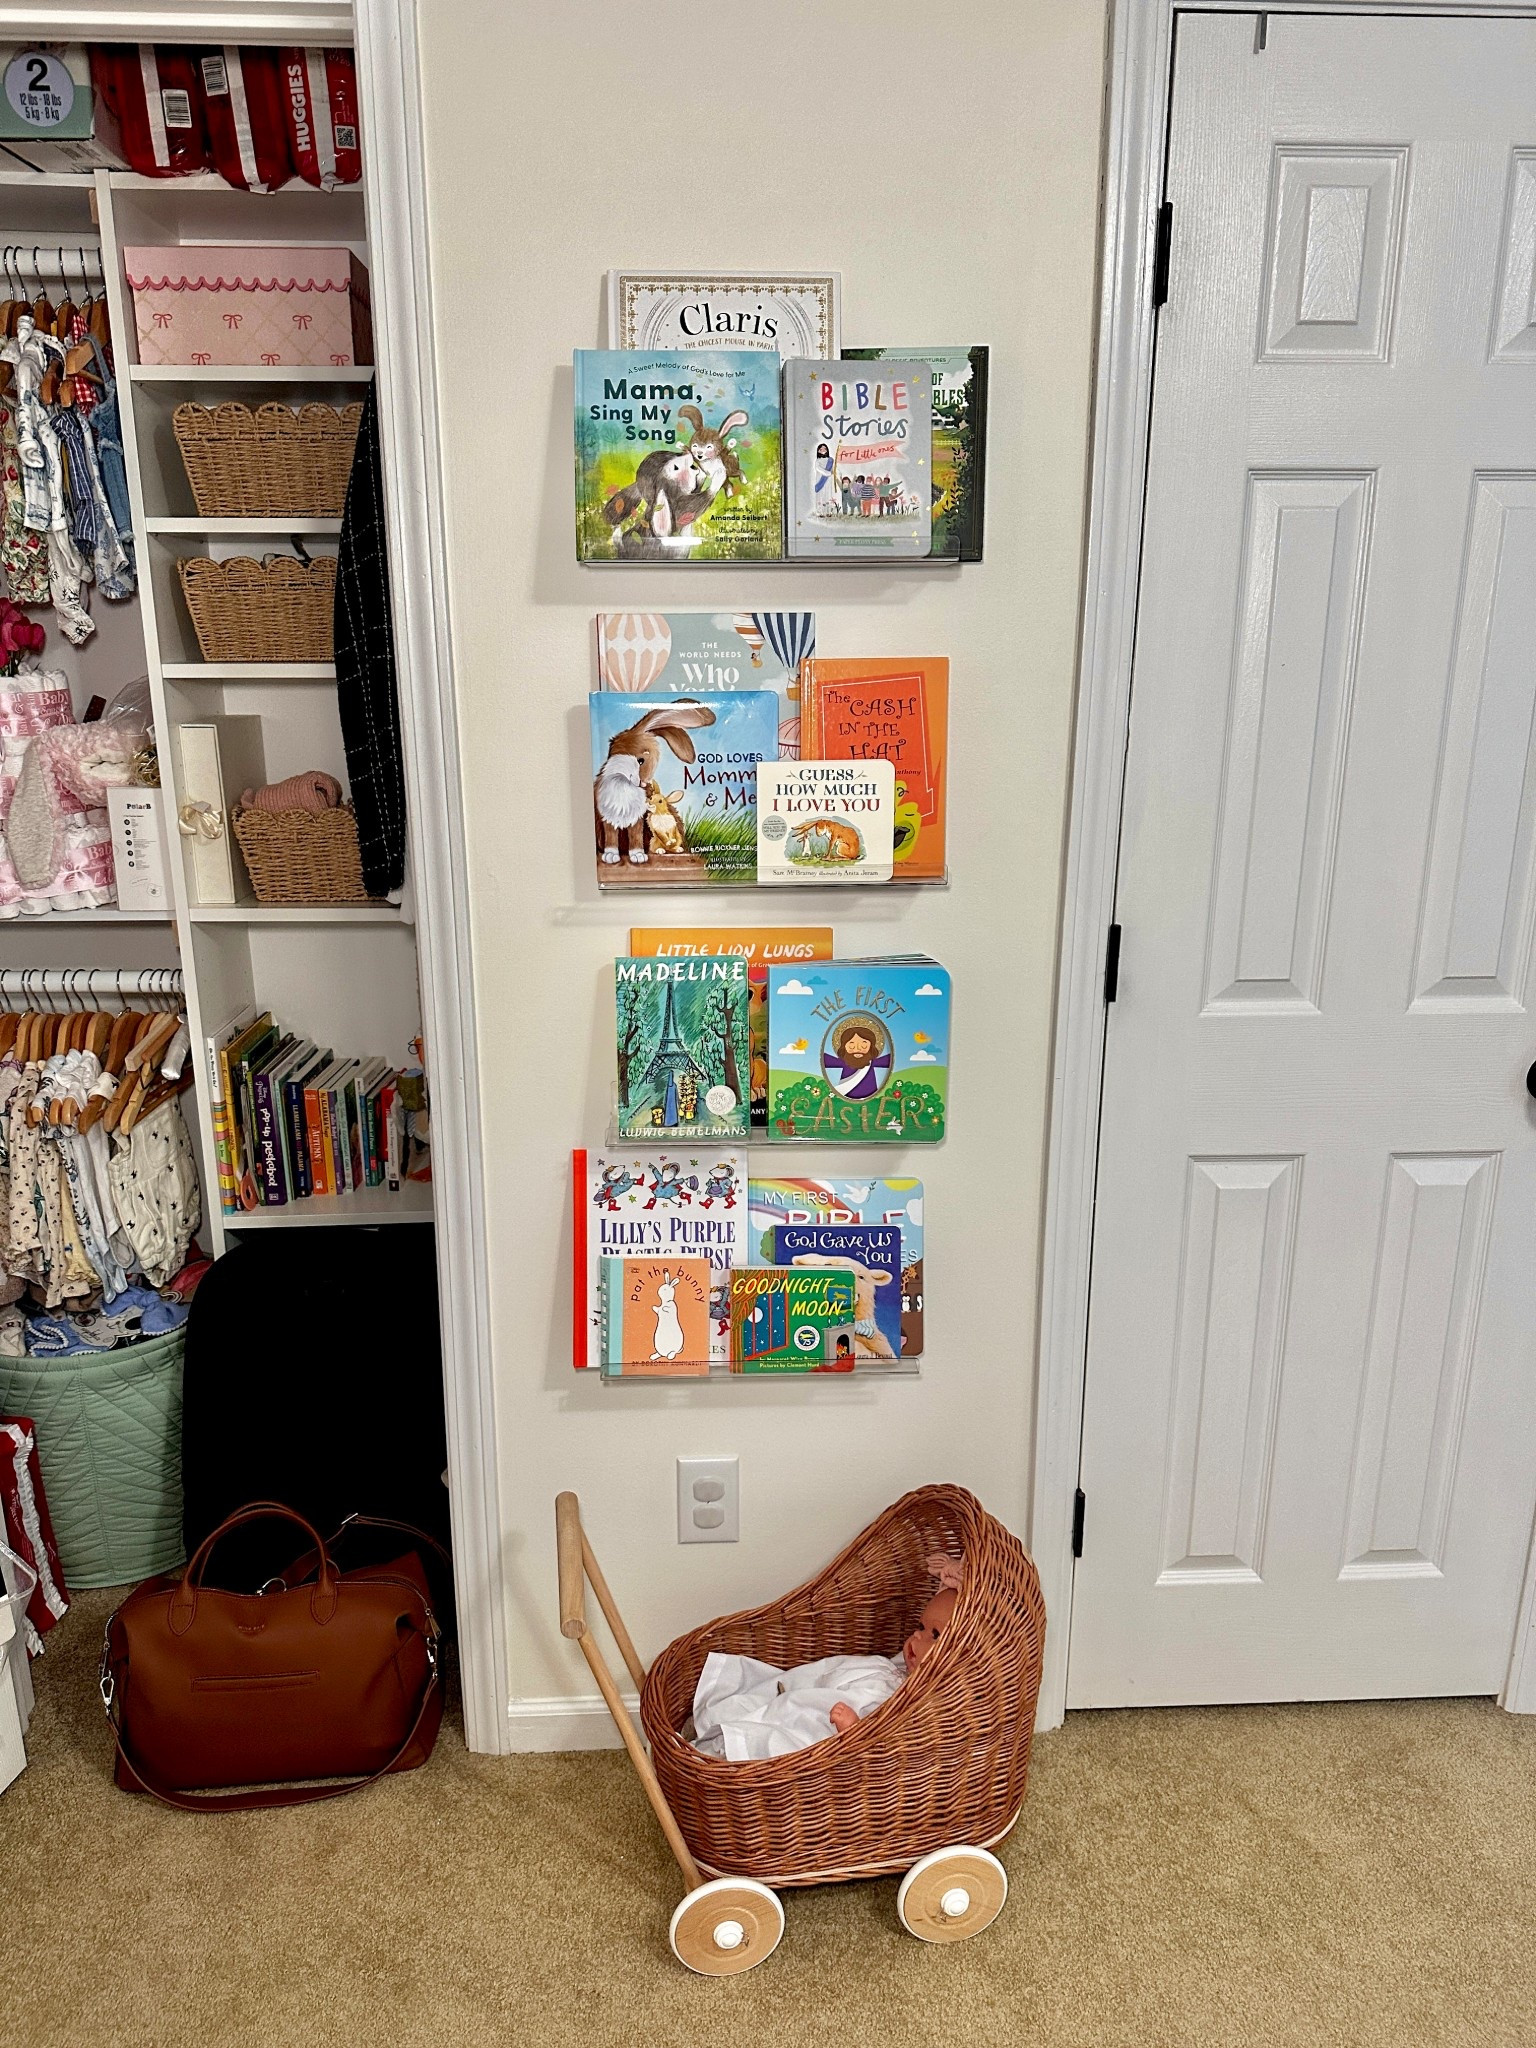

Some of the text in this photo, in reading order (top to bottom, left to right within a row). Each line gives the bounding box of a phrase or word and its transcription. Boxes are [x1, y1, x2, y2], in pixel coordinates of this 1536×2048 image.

[27, 58, 50, 91] 2
[20, 93, 26, 105] 12
[28, 93, 38, 105] lbs
[51, 94, 61, 106] lbs
[288, 64, 311, 152] HUGGIES
[25, 107, 30, 118] 5
[31, 107, 40, 120] kg
[45, 107, 50, 119] 8
[51, 108, 59, 120] kg
[680, 303, 778, 338] Claris
[634, 364, 654, 373] Sweet
[691, 366, 708, 375] God's
[932, 373, 943, 385] OF
[604, 378, 703, 403] Mama,
[822, 383, 908, 410] BIBLE
[933, 390, 963, 405] BLES
[590, 405, 671, 424] Sing My
[626, 426, 676, 444] Song
[822, 415, 908, 439] Stories
[840, 451, 854, 460] for
[682, 663, 739, 689] Who
[824, 690, 851, 703] The
[850, 697, 916, 719] CASH
[839, 722, 900, 738] IN THE
[698, 753, 763, 763] GOD LOVES
[849, 739, 906, 760] HAT
[684, 766, 757, 789] Momm
[800, 769, 854, 781] GUESS
[706, 786, 757, 810] & Me
[776, 784, 877, 796] HOW MUCH
[773, 798, 880, 812] I LOVE YOU
[87, 843, 112, 860] Bab
[656, 944, 814, 958] LITTLE LION LUNGS
[618, 962, 744, 981] MADELINE
[811, 985, 906, 1021] THE FIRST
[619, 1125, 747, 1137] LUDWIG BEMELMANS
[764, 1192, 838, 1205] MY FIRST
[600, 1217, 735, 1244] LILLY'S PURPLE
[785, 1231, 817, 1248] God
[820, 1232, 866, 1248] Gave
[856, 1247, 893, 1265] You
[631, 1266, 705, 1303] pat the bunny
[733, 1278, 834, 1294] GOODNIGHT
[792, 1301, 844, 1316] MOON
